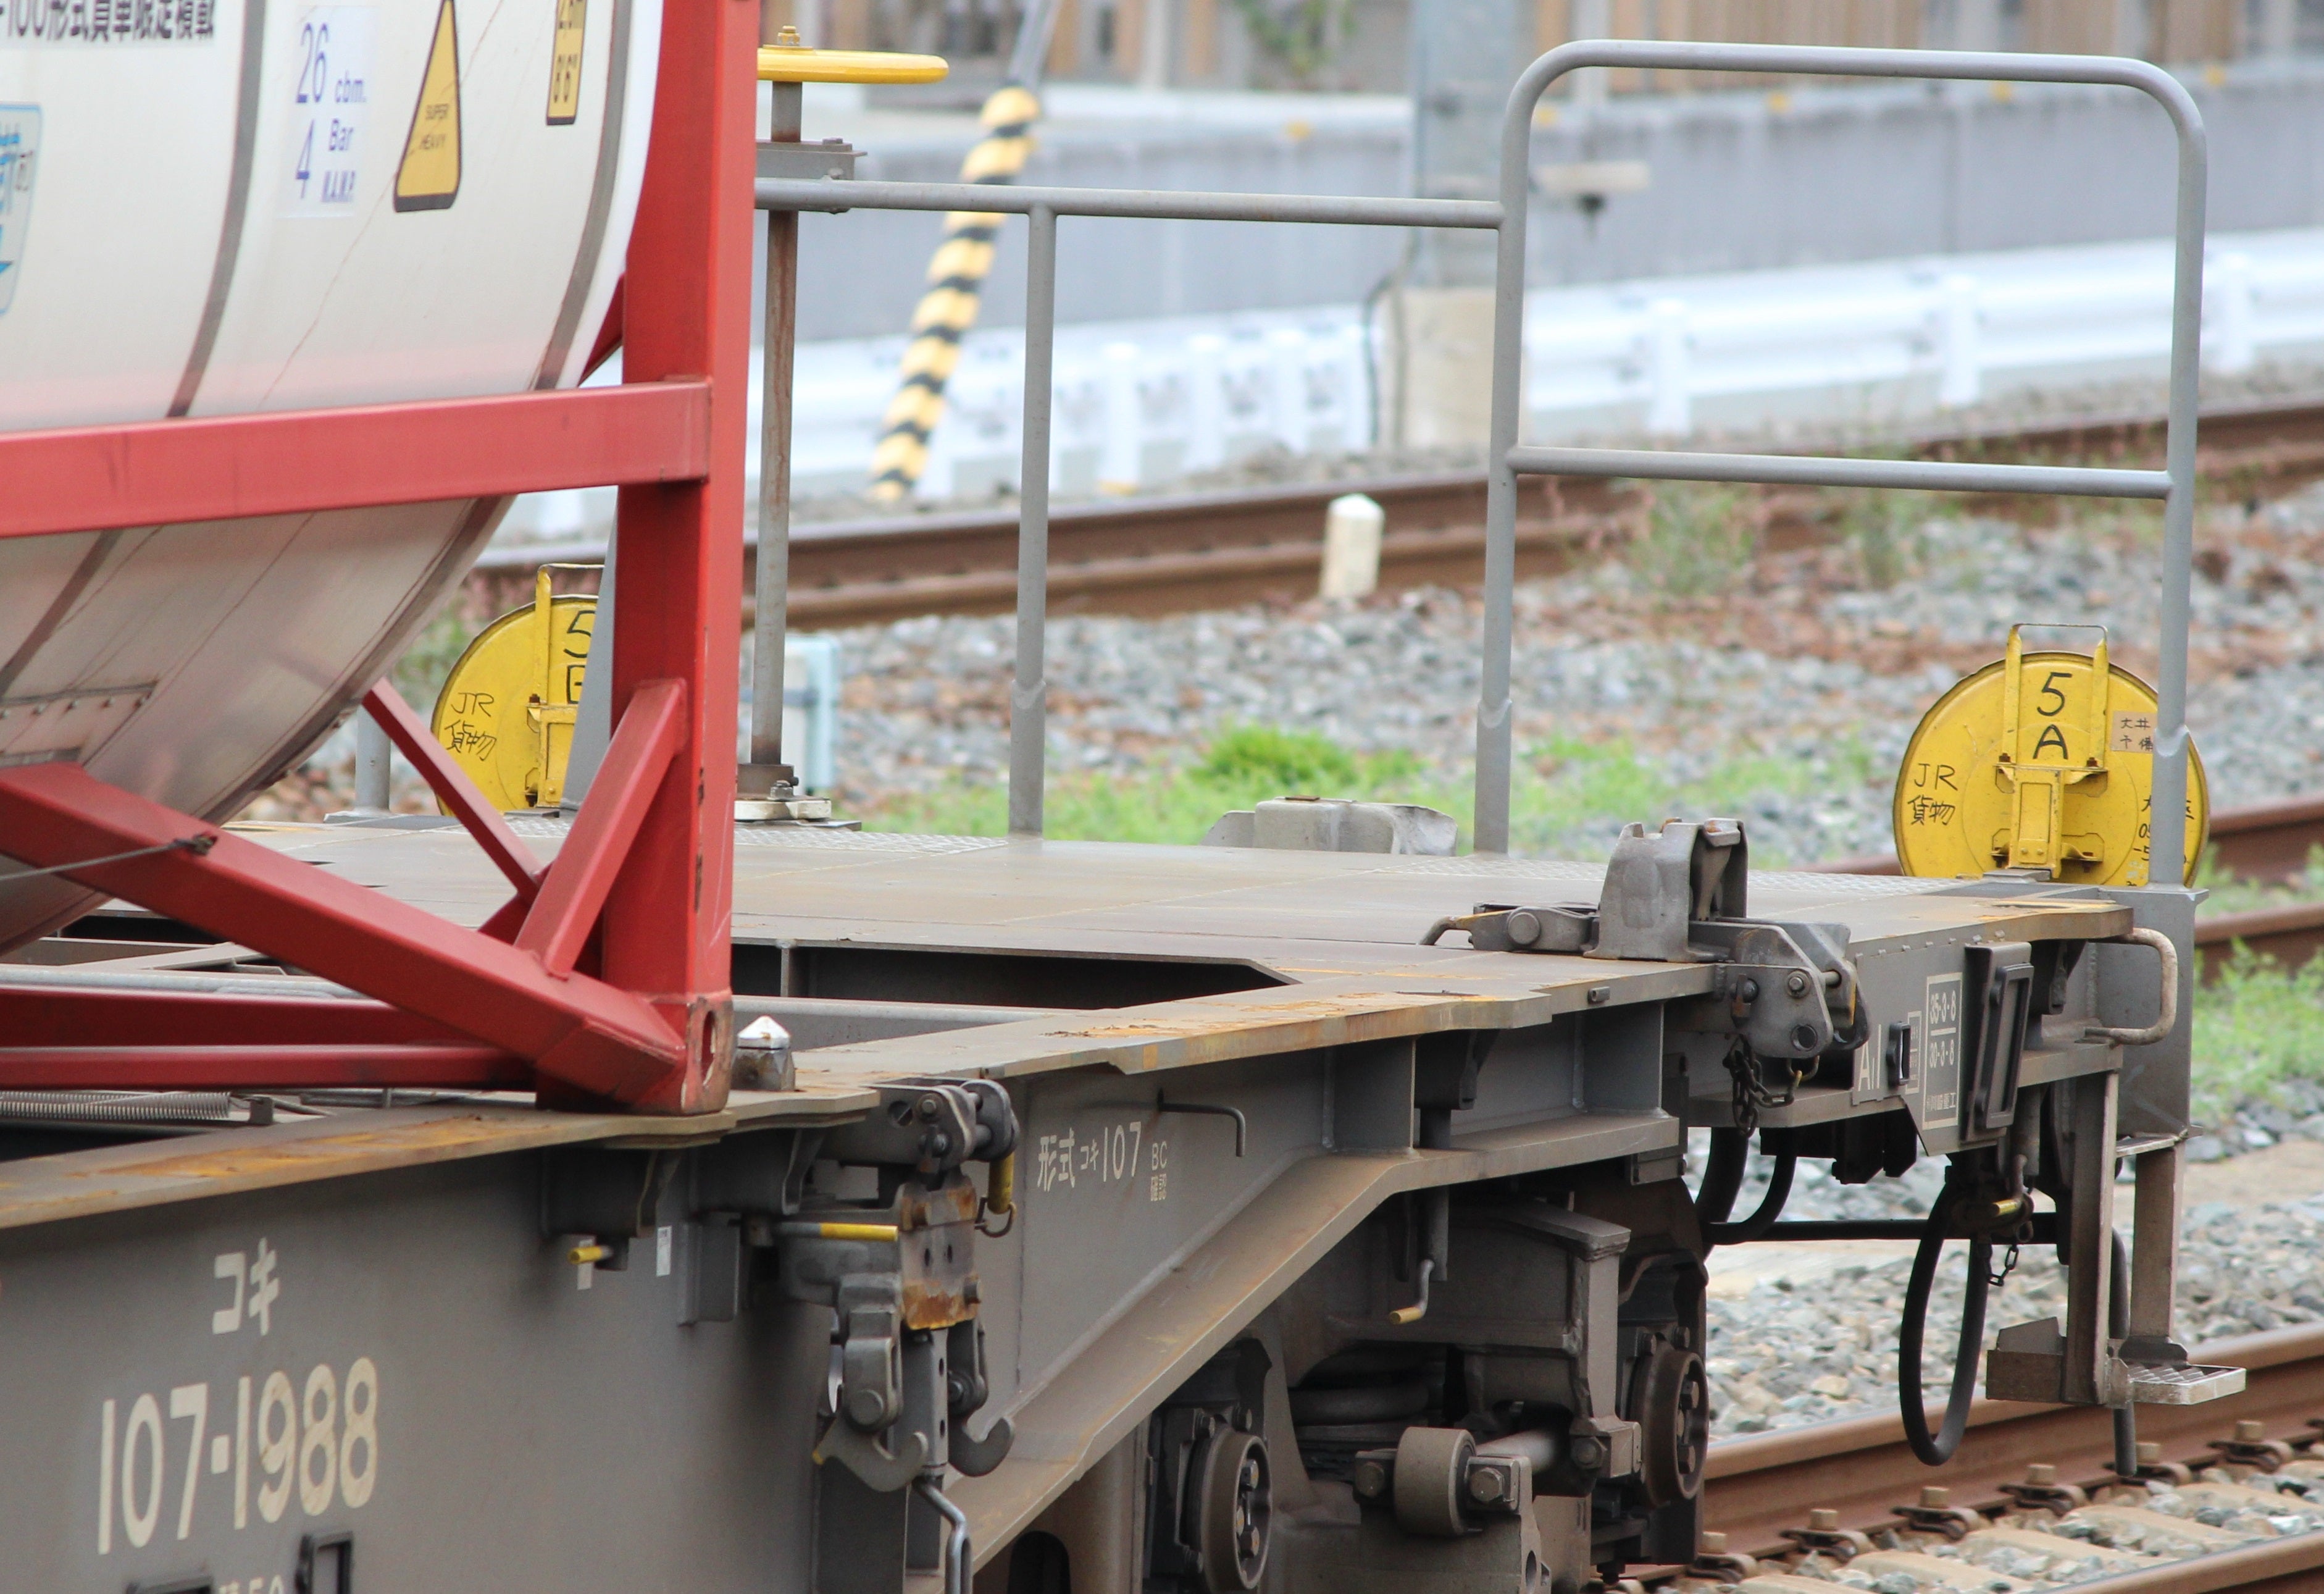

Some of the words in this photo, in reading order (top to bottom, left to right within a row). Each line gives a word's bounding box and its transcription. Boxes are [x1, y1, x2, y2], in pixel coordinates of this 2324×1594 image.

[296, 22, 328, 103] 26
[296, 119, 316, 199] 4
[328, 118, 354, 151] Bar
[563, 610, 596, 658] 5
[451, 692, 495, 718] JR
[2036, 671, 2073, 716] 5
[444, 719, 497, 761] 貨物
[2032, 724, 2069, 760] A
[1913, 762, 1958, 791] JR
[1907, 794, 1955, 826] 貨物
[1152, 1141, 1168, 1171] BC
[212, 1237, 279, 1336] コキ
[98, 1357, 377, 1555] 107-1988
